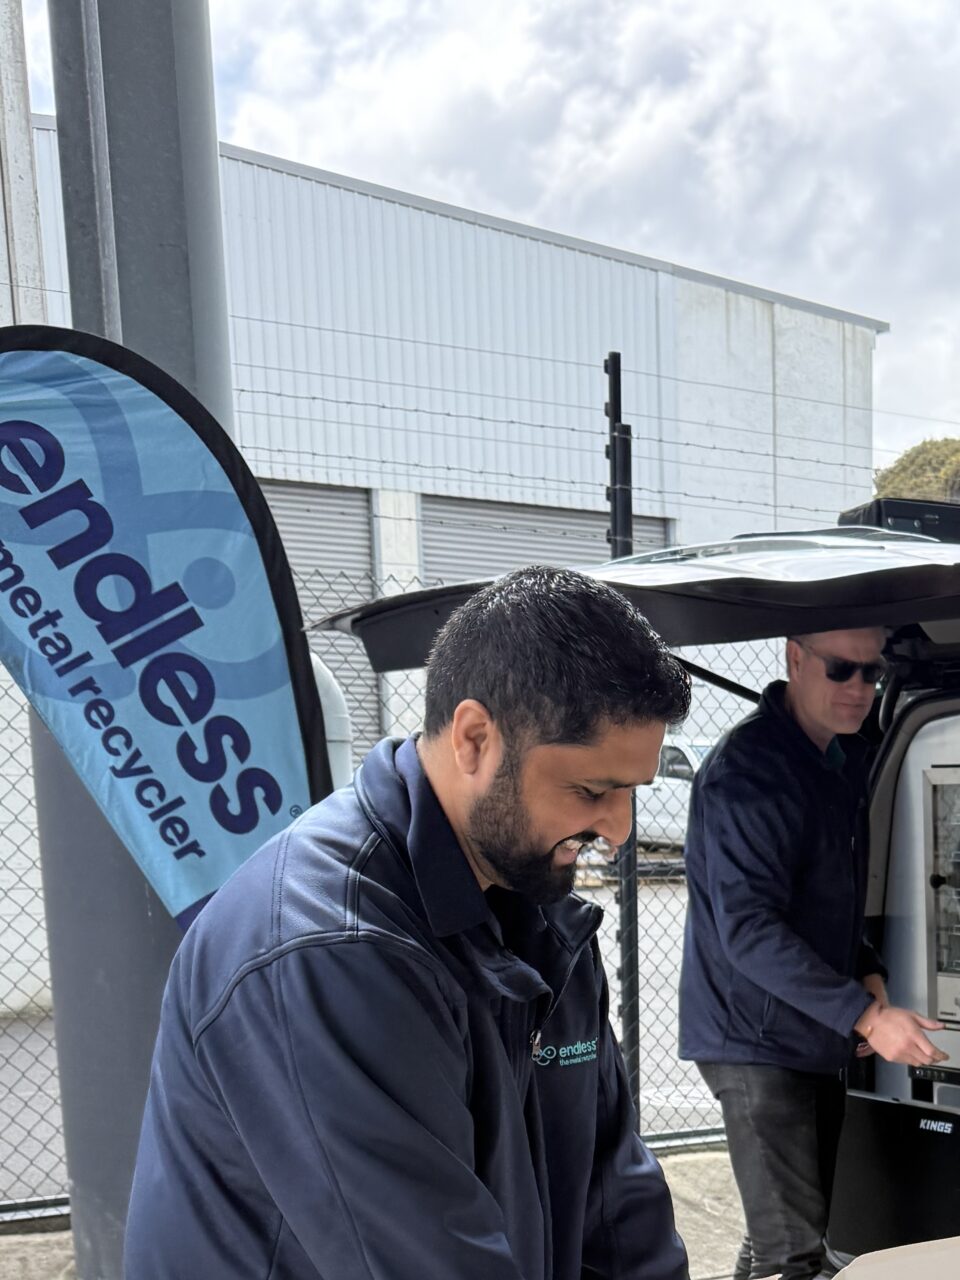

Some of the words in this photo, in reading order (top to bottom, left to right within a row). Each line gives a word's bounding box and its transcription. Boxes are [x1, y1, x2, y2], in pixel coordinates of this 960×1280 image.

[0, 420, 282, 834] endless
[0, 539, 94, 678] metal
[68, 676, 206, 860] recycler
[559, 1040, 597, 1058] endless
[919, 1118, 953, 1134] KINGS
